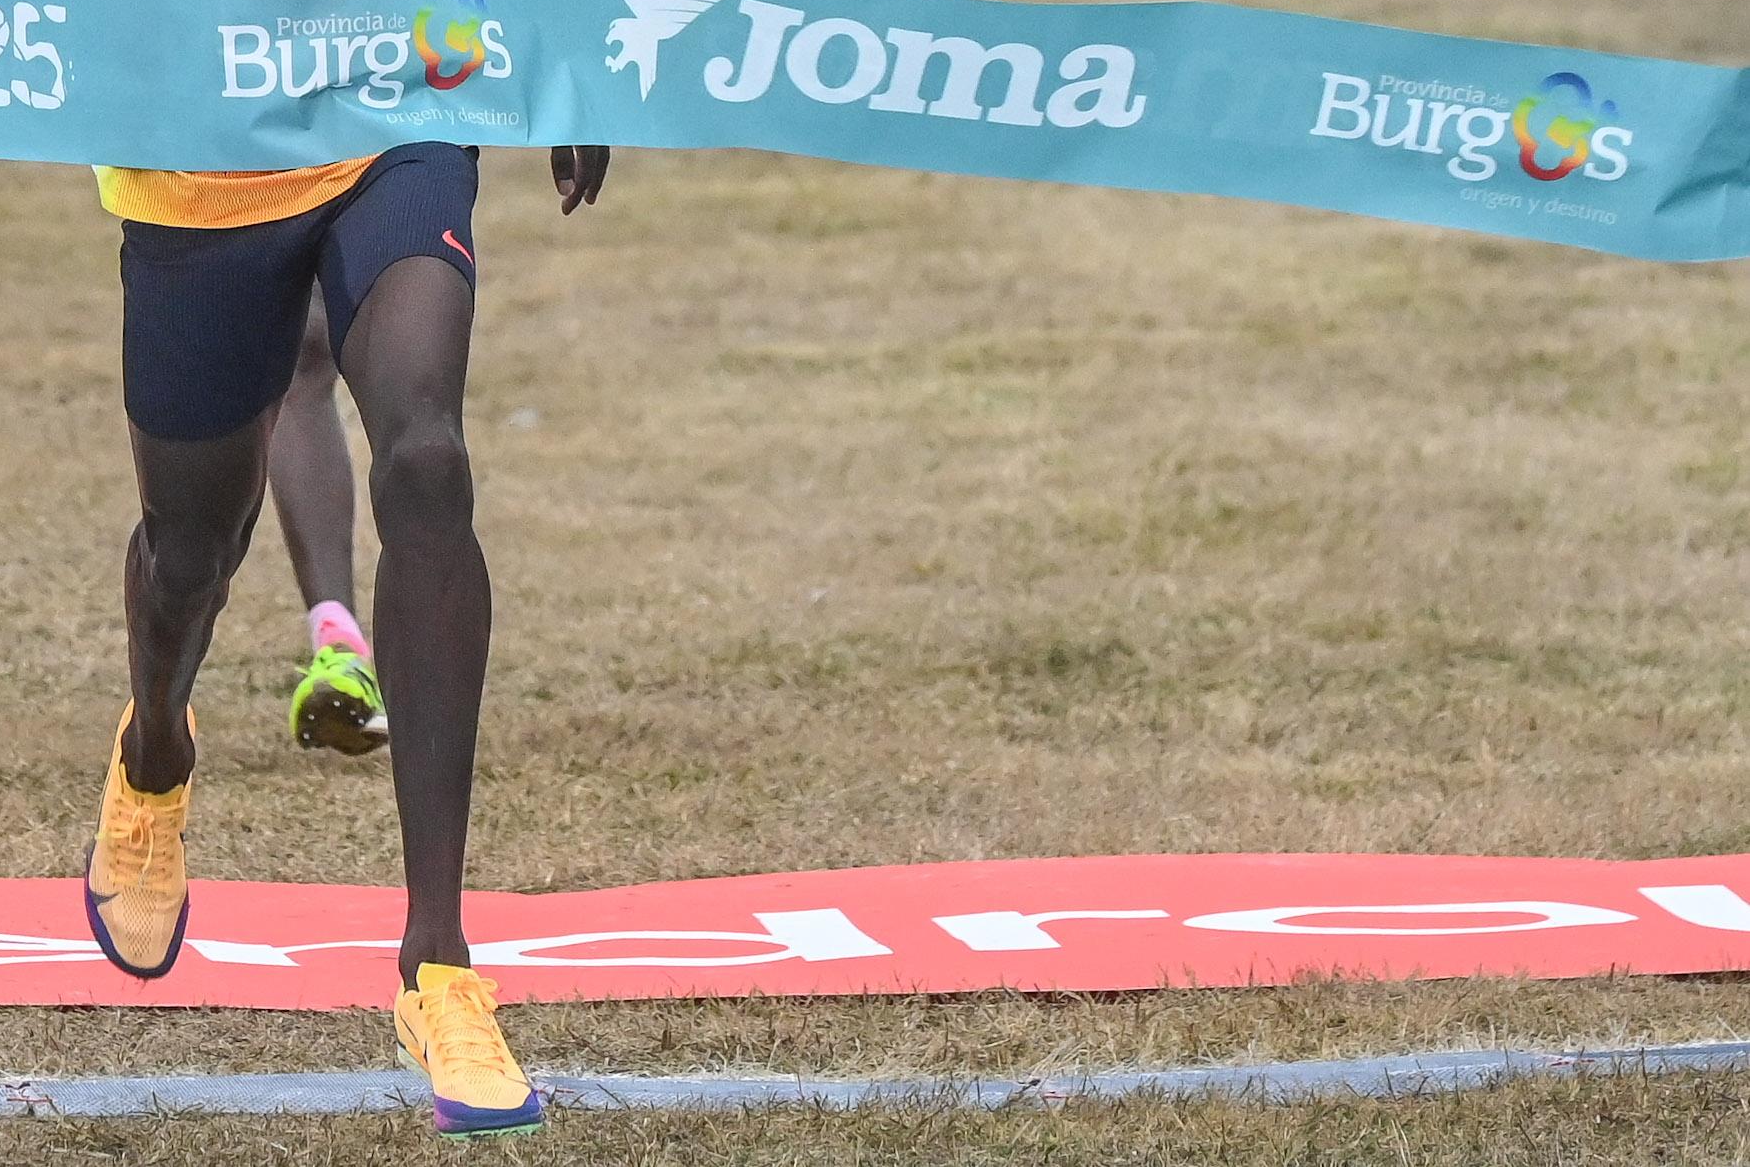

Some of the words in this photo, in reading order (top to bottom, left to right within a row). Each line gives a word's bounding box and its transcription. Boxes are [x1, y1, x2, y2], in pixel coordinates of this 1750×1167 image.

[275, 10, 384, 37] Provincia
[386, 12, 407, 30] de
[1377, 73, 1485, 105] Provincia
[1486, 91, 1510, 109] de
[385, 107, 443, 126] origen
[444, 109, 456, 125] y
[458, 106, 520, 126] destino
[1309, 71, 1634, 182] Burgos
[1459, 185, 1523, 210] origen
[1527, 199, 1540, 215] y
[1543, 196, 1618, 226] destino
